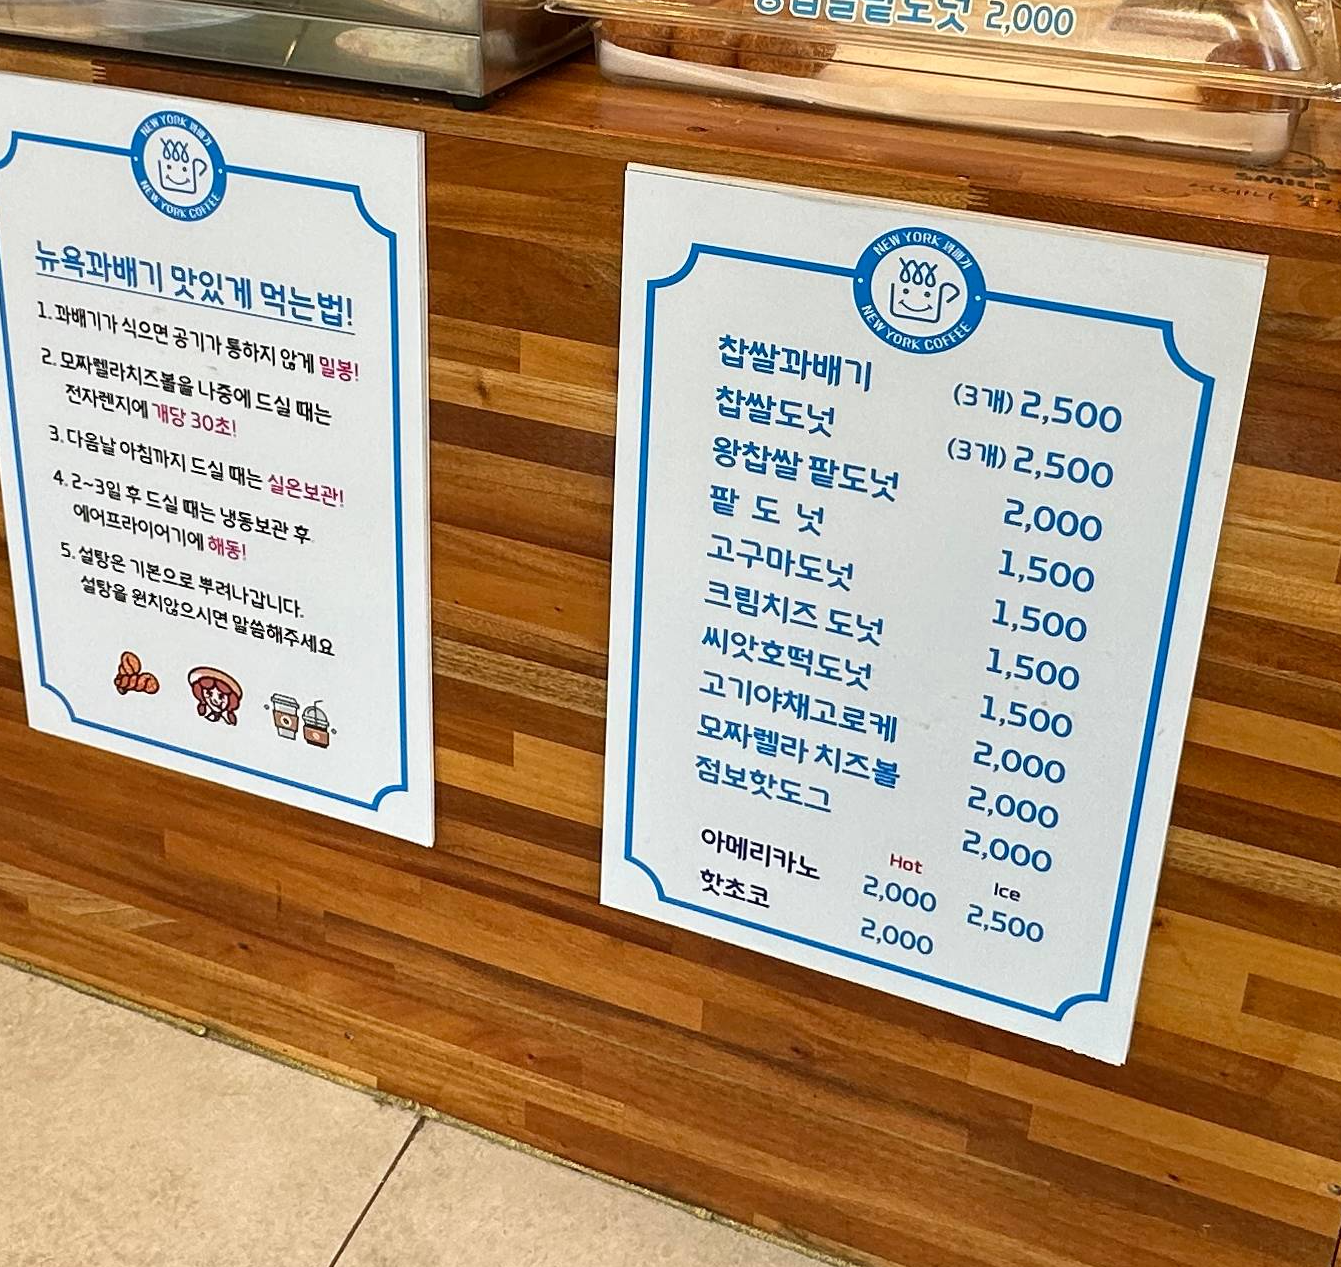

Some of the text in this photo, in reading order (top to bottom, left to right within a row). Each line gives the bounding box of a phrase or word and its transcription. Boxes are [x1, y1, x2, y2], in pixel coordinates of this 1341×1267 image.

[986, 0, 1076, 36] 2,000
[140, 118, 159, 138] NEW
[159, 114, 188, 128] YORK
[139, 180, 160, 204] NEW
[160, 202, 187, 219] YORK
[35, 239, 354, 328] 뉴욕꽈배기 맛있게 먹는법!
[872, 234, 901, 256] NEW
[902, 231, 943, 247] YORK
[36, 300, 359, 382] 1. 꽈배기가 식으면 공기가 통하지 않게 밀봉!
[861, 305, 972, 351] NEW YORK COFFEE
[40, 346, 333, 427] 2. 모짜렐라치즈볼을 나중에 드실 때는
[65, 383, 237, 438] 전자렌지에 개당 30초!
[718, 333, 1123, 434] 찹쌀꽈배기 (3개) 2,500
[47, 424, 344, 508] 3. 다음날 아침까지 드실 때는 실온보관!
[715, 385, 1114, 489] 찹쌀도넛 (3개) 2,500
[52, 469, 69, 487] 4.
[125, 484, 143, 505] 후
[145, 490, 179, 515] 드실
[182, 498, 217, 524] 때는
[219, 506, 284, 541] 냉동보관
[287, 524, 312, 545] 후
[712, 436, 1103, 542] 왕찹쌀 팥도넛 2,000
[72, 503, 247, 561] 에어프라이어기에 해동!
[998, 549, 1095, 593] 1,500
[60, 541, 305, 619] 5. 설탕은 기본으로 뿌려나갑니다.
[80, 575, 336, 657] 설탕을 원치않으시면 말씀해주세요
[706, 533, 1088, 643] 고구마도넛 1,500
[703, 580, 1080, 691] 크림치즈 도넛 1,500
[701, 626, 1073, 739] 씨앗호떡도넛 1,500
[698, 669, 1066, 784] 고기야채고로케 2,000
[696, 713, 1059, 830] 모짜렐라 치즈볼 2,000
[695, 754, 1053, 873] 점보핫도그 2,000
[699, 868, 934, 956] 핫초코 2,000
[700, 828, 1045, 943] 아메리카노 2,000 2,500
[889, 852, 1021, 903] Hot Ice
